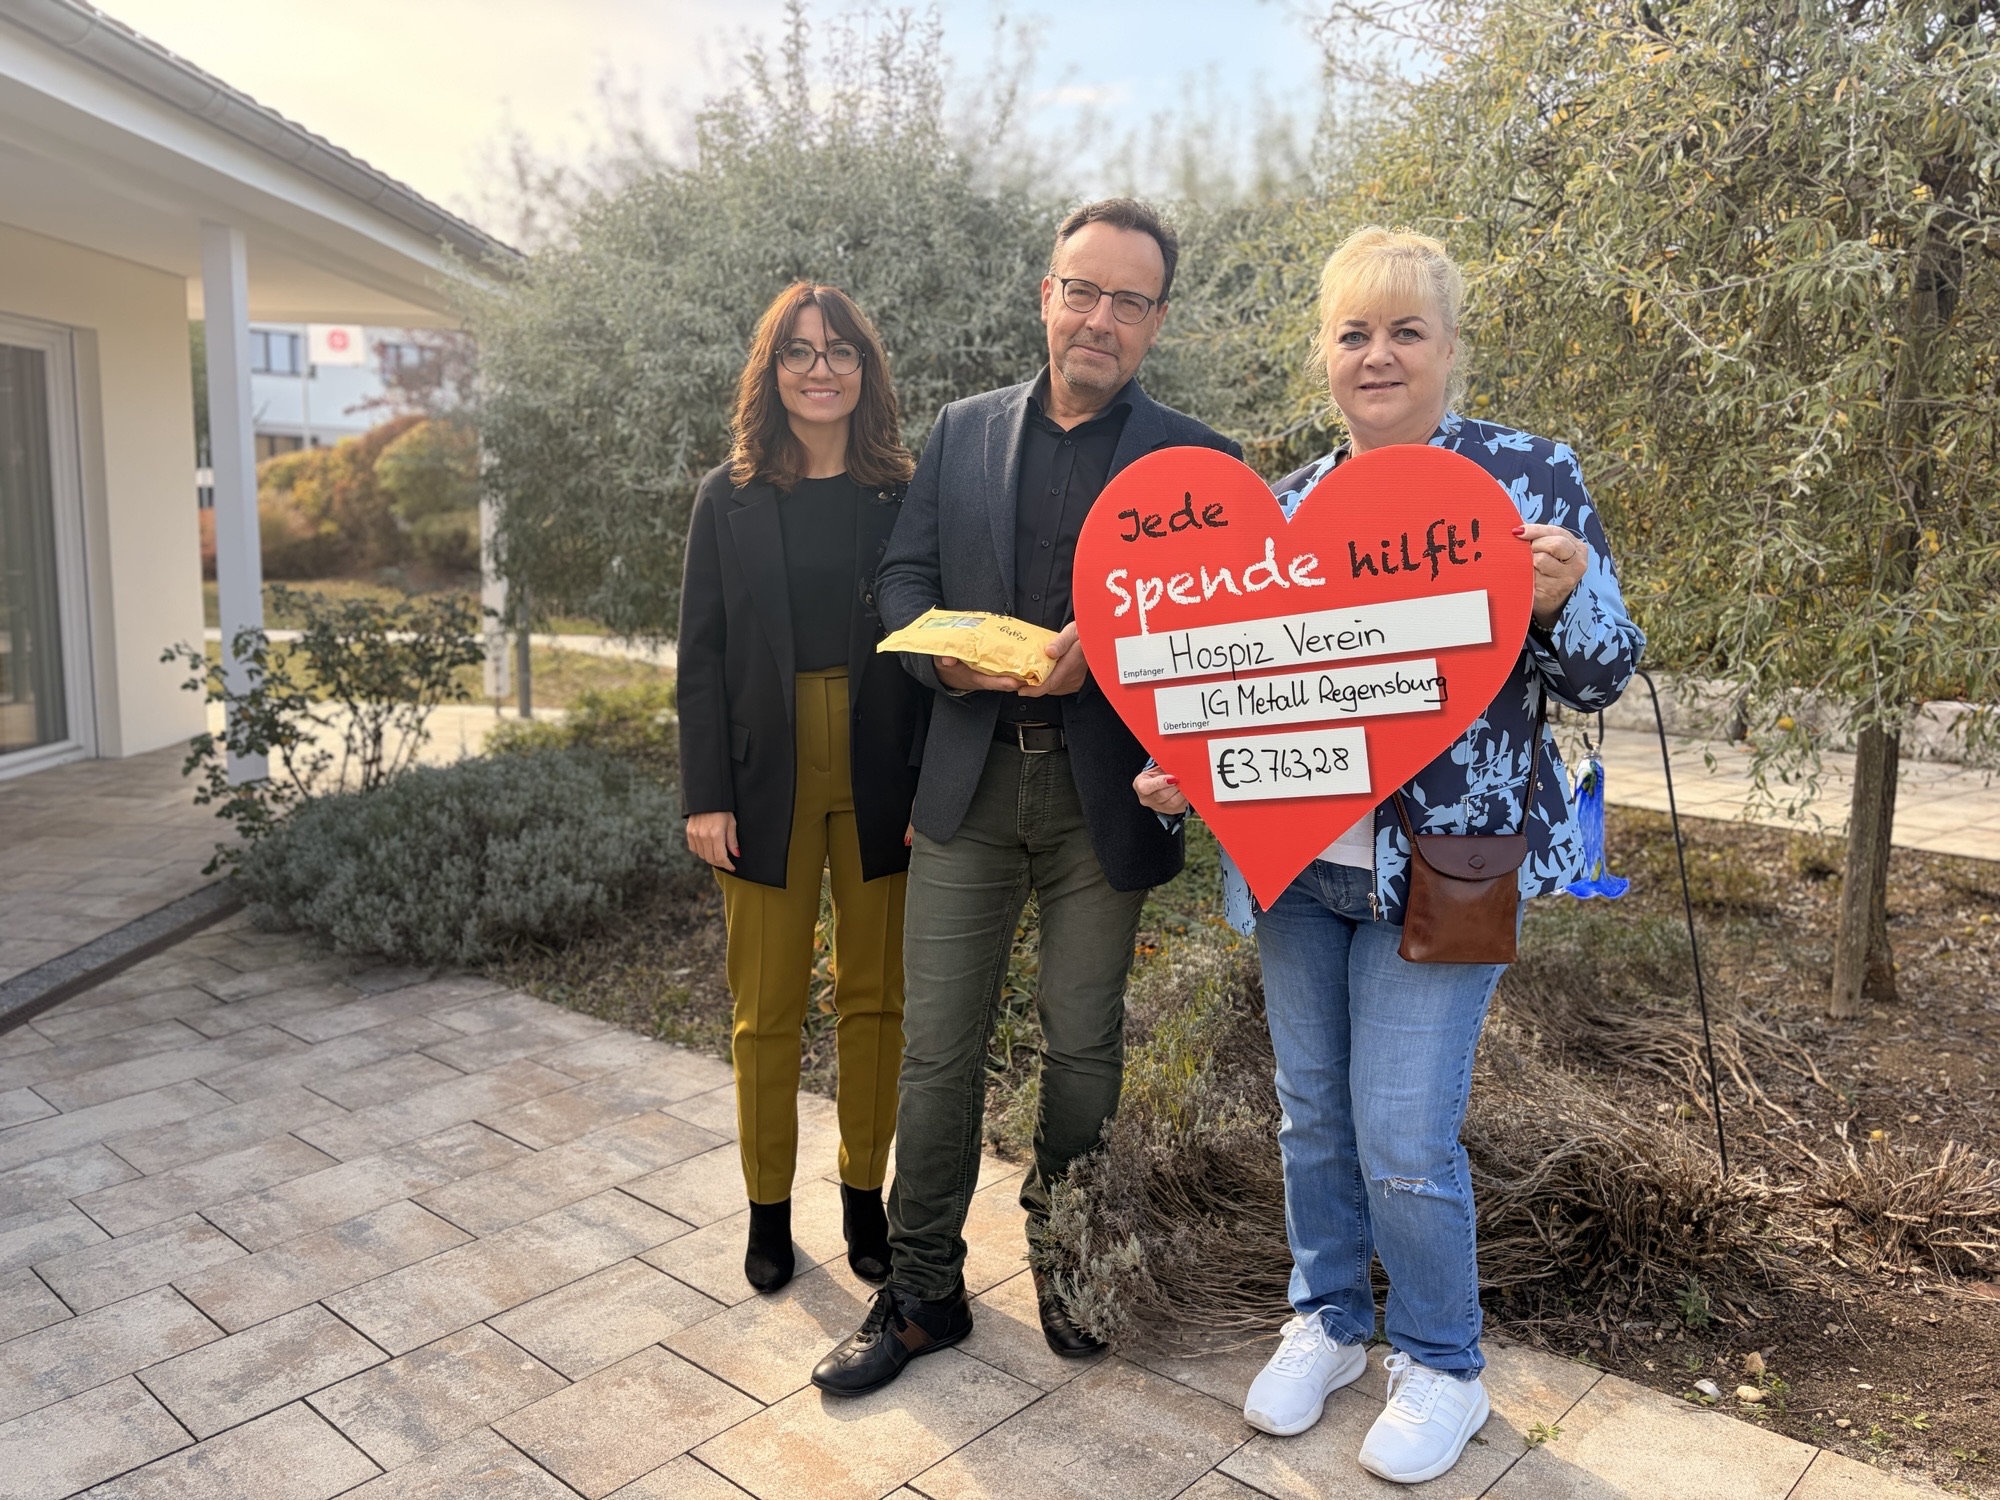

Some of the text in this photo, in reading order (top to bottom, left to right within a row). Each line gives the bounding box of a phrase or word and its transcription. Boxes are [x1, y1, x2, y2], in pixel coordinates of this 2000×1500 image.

[1117, 491, 1229, 542] Jede
[1105, 519, 1482, 639] Spende hilft!
[1123, 666, 1165, 679] Empfänger
[1169, 619, 1385, 680] Hospiz Verein
[1200, 670, 1448, 721] IG Metall Regensburg
[1163, 717, 1210, 731] Überbringer
